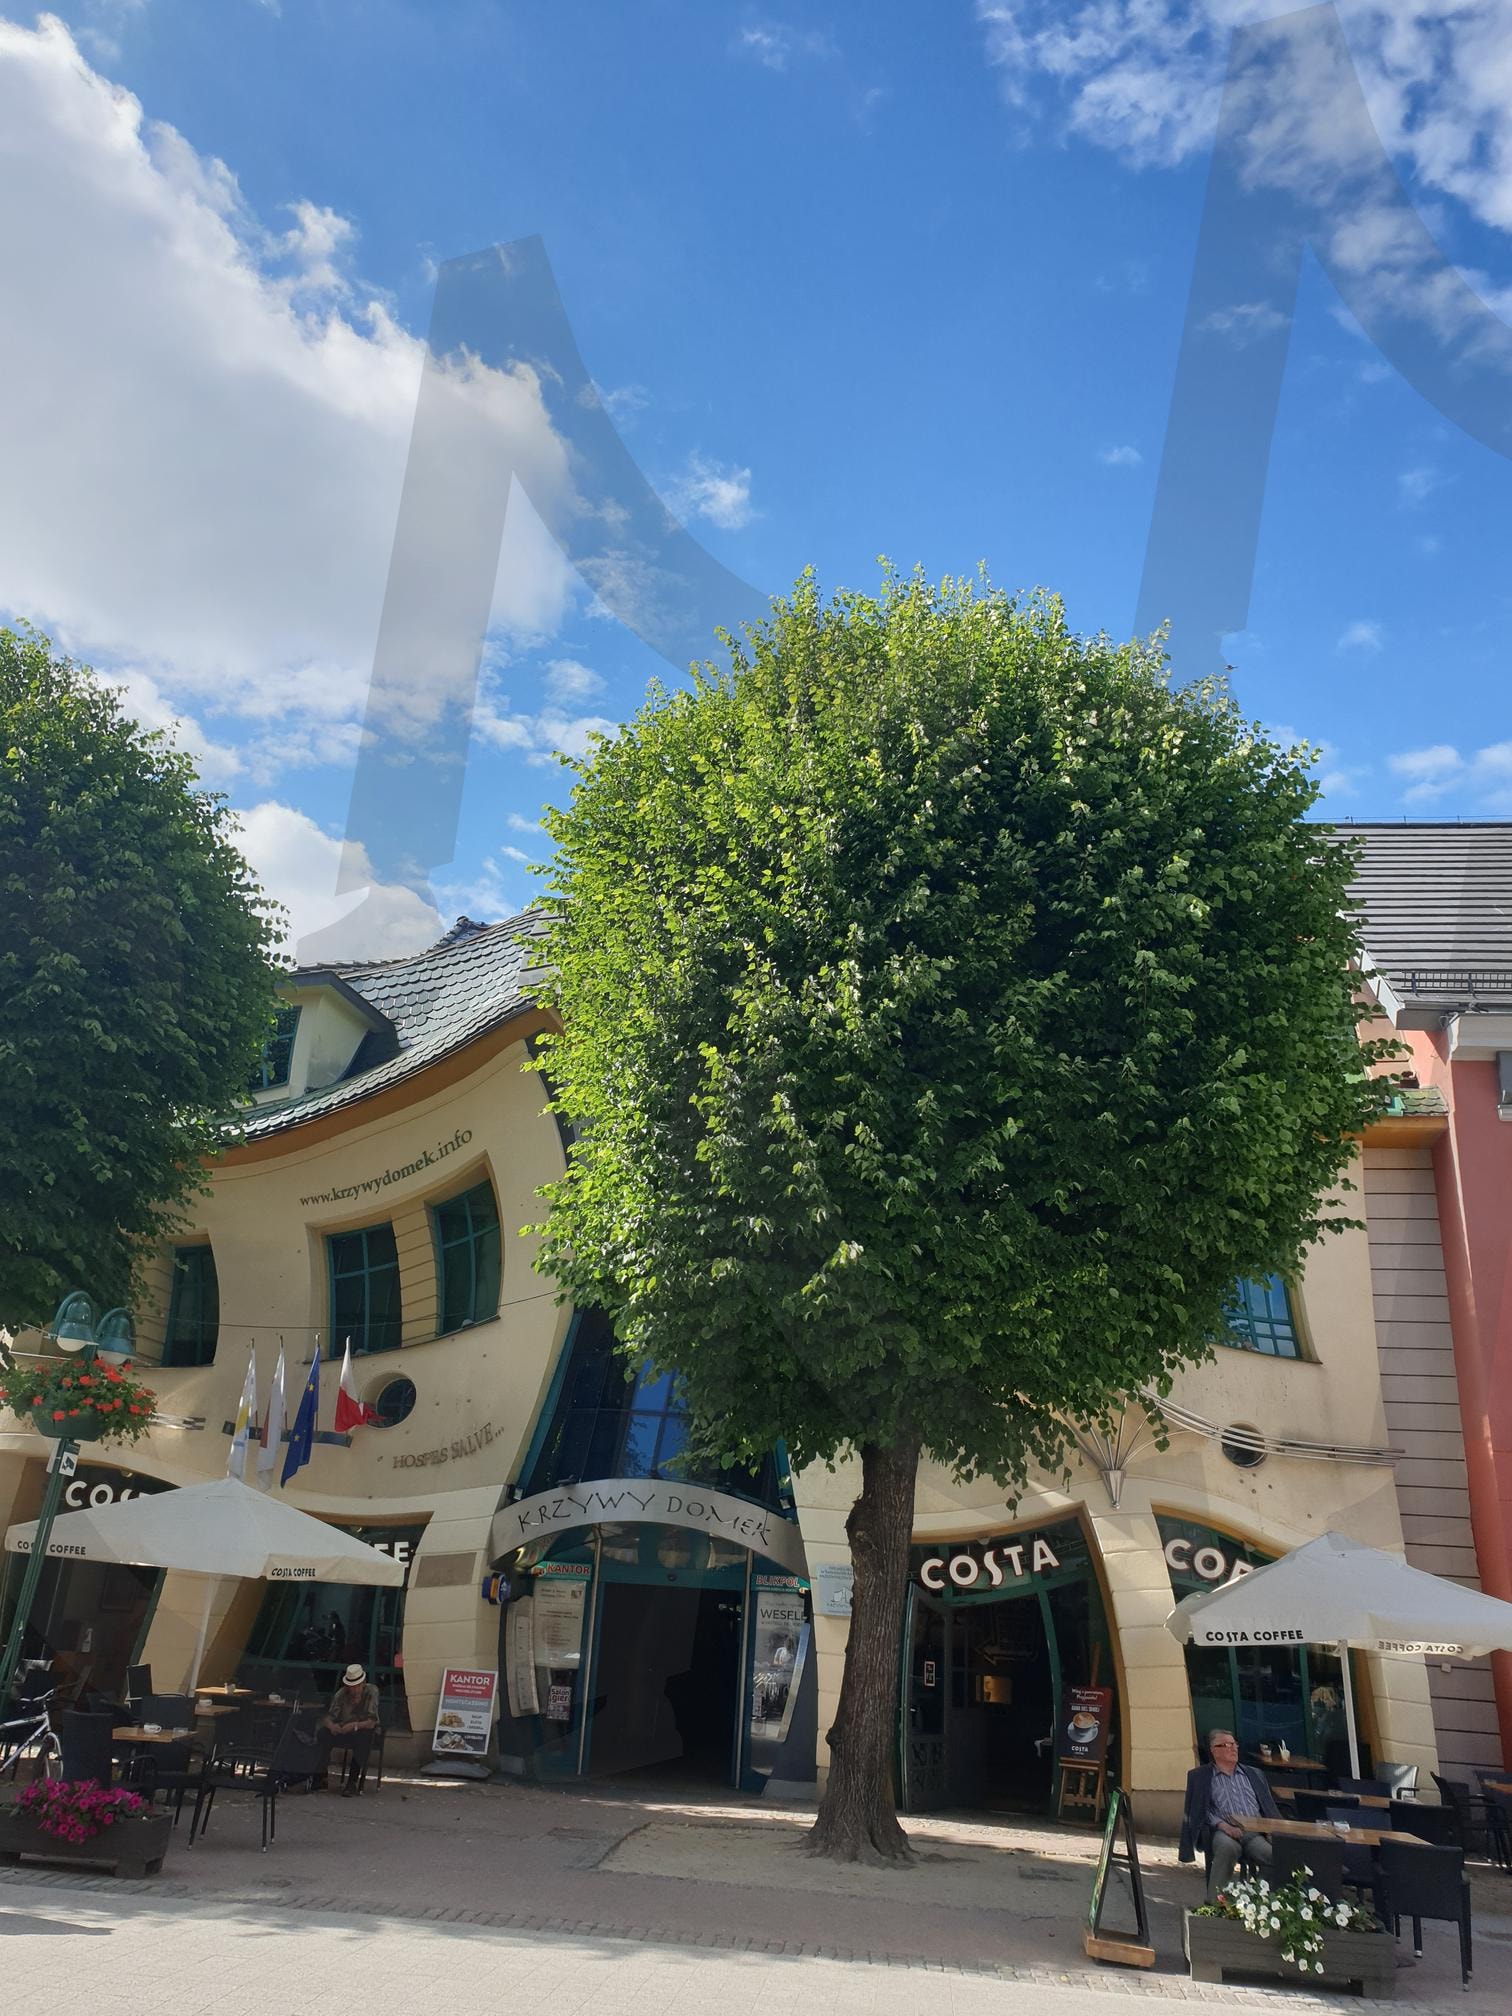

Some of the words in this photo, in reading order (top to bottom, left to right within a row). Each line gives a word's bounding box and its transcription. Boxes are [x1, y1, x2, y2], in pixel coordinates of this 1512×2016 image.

[299, 1128, 473, 1206] www.krzywydomek.info
[65, 1480, 152, 1508] CO
[518, 1491, 656, 1533] KRZYWY
[667, 1496, 771, 1546] DOMEK
[50, 1543, 86, 1556] COFFEE
[546, 1563, 590, 1575] KANTOR
[920, 1539, 1060, 1589] COSTA
[271, 1567, 292, 1578] COSTA
[294, 1568, 316, 1577] COFFEE
[760, 1608, 807, 1621] WESEL
[1206, 1631, 1248, 1643] COSTA
[1253, 1630, 1304, 1641] COFFEE
[450, 1674, 490, 1686] KANTOR
